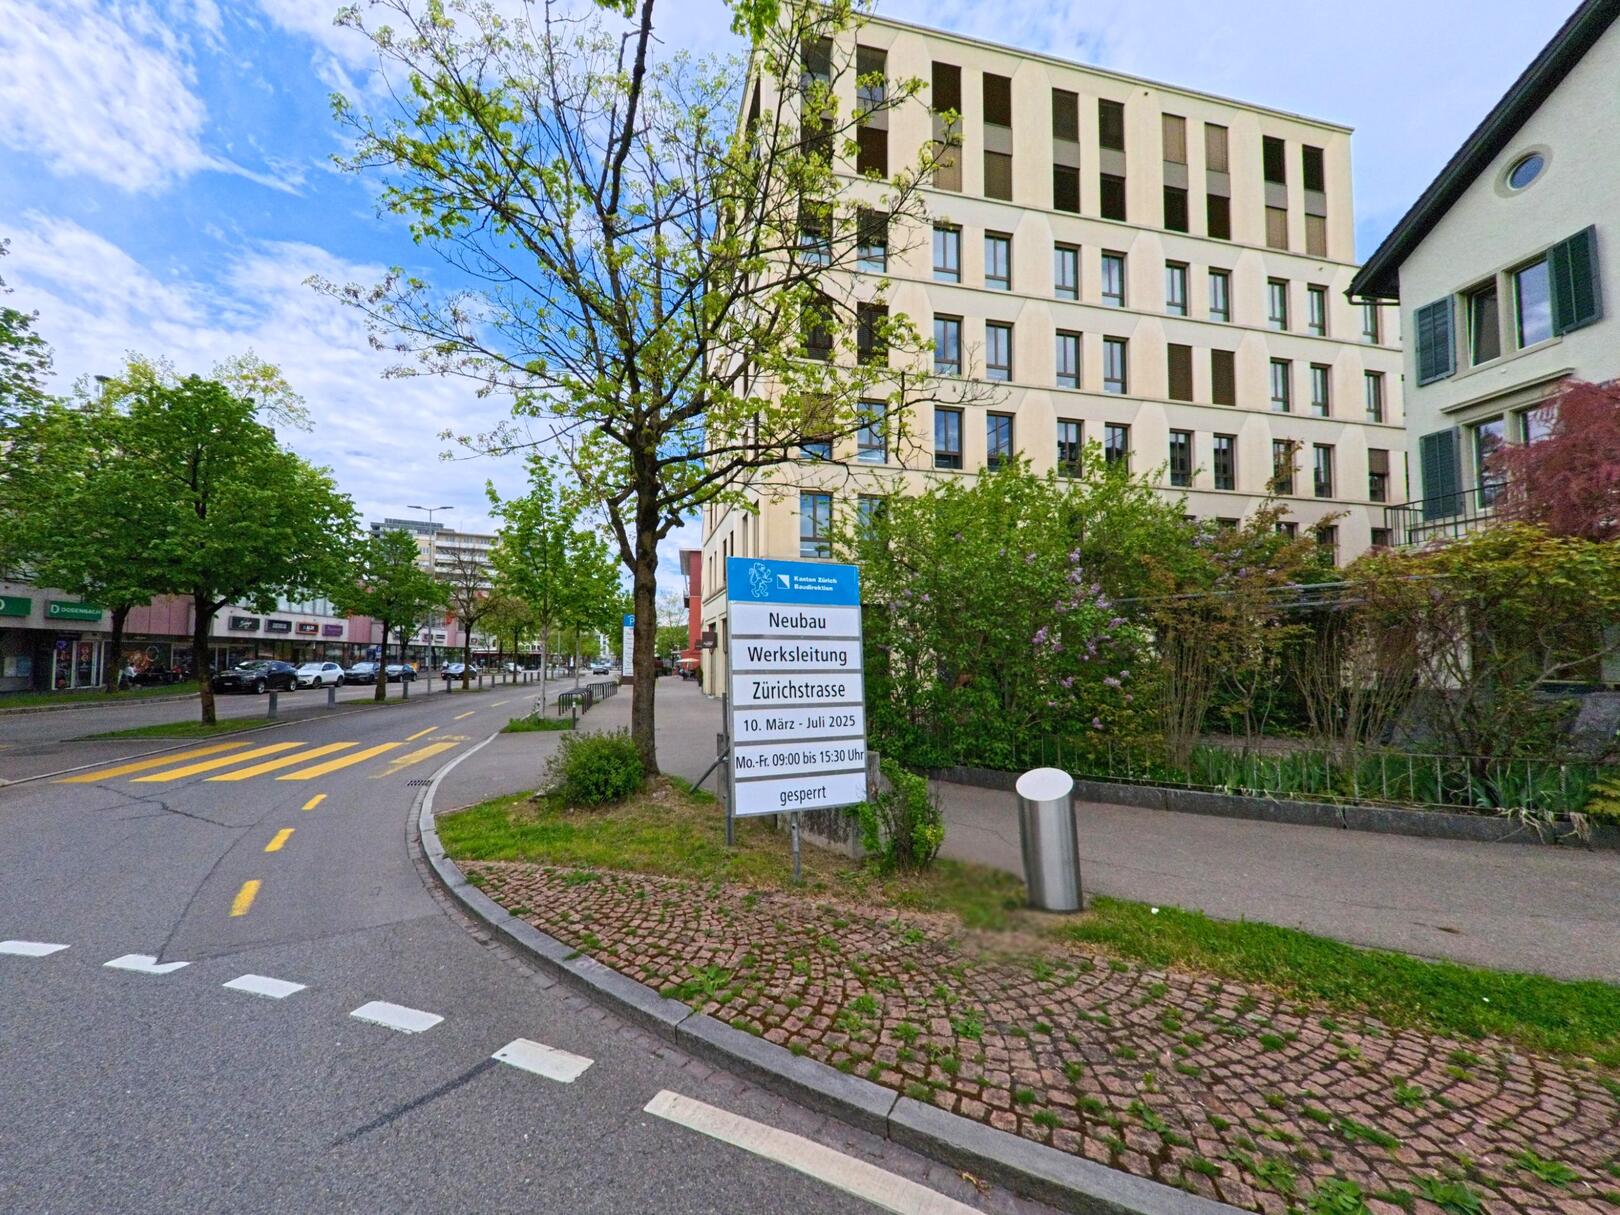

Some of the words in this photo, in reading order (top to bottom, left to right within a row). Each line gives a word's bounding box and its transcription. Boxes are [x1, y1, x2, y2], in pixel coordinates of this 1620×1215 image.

[61, 607, 101, 615] DOSENBACH
[769, 612, 826, 629] Neubau
[747, 645, 848, 666] Werksleitung
[752, 680, 846, 700] Zürichstrasse
[743, 719, 762, 732] 10.
[766, 718, 795, 731] März
[806, 716, 825, 729] Juli
[829, 715, 856, 728] 2025
[735, 755, 770, 769] Mo.-Fr.
[772, 752, 800, 767] 09:00
[802, 751, 817, 764] bis
[820, 749, 846, 763] 15:30
[847, 748, 864, 762] Uhr
[779, 786, 826, 807] gesperrt
